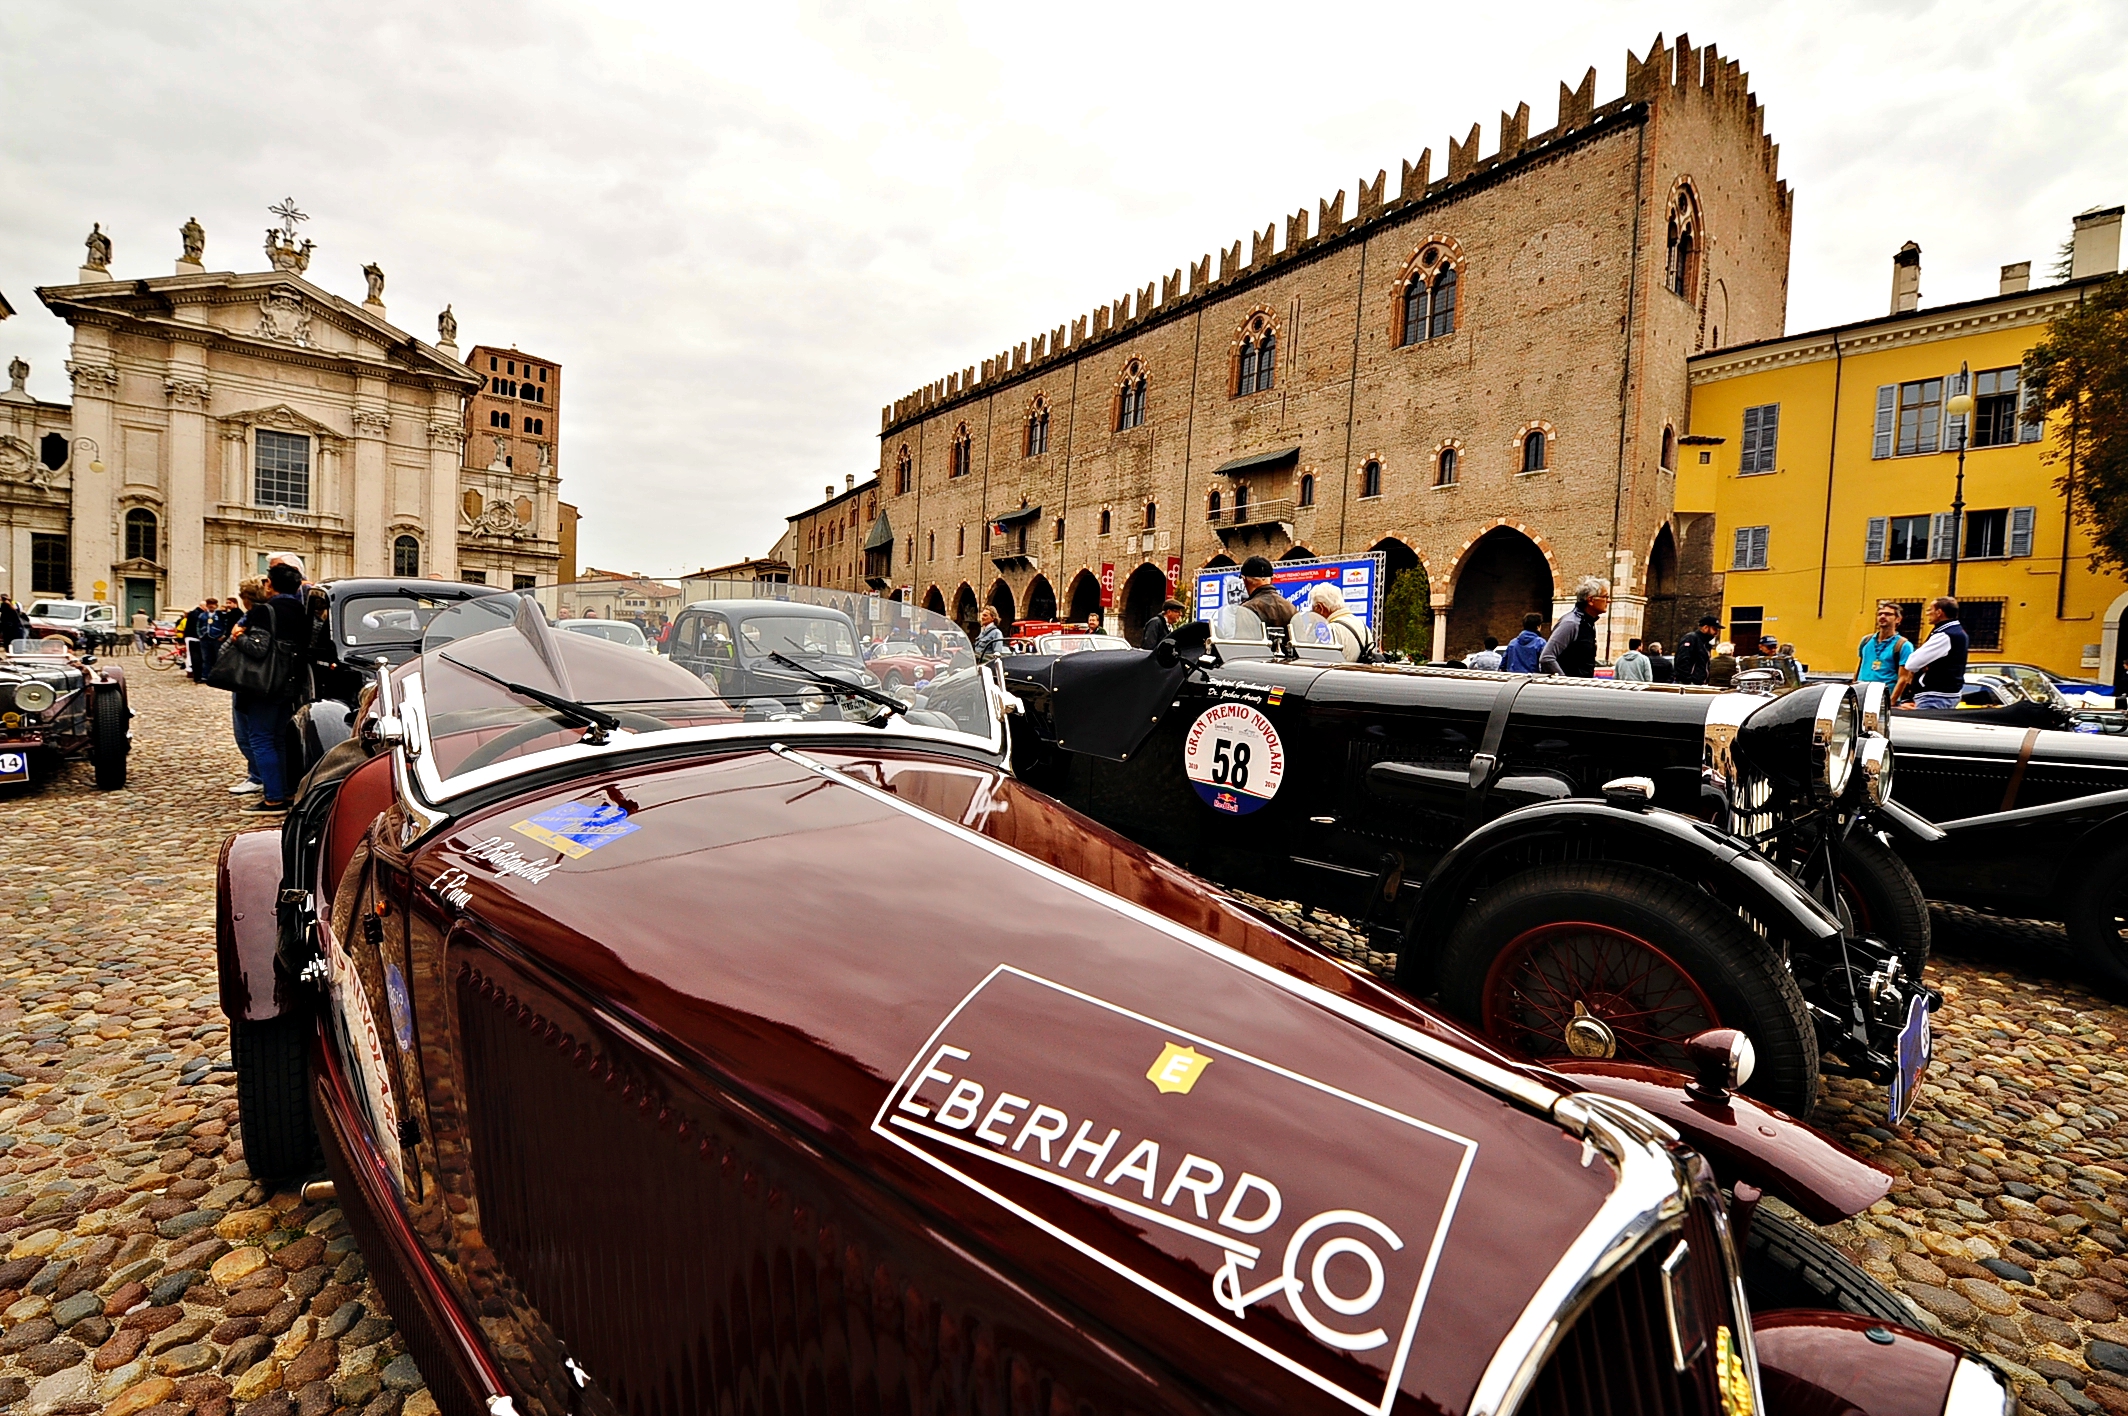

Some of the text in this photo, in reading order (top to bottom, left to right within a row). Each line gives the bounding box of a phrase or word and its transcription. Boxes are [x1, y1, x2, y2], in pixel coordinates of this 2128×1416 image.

[1187, 706, 1282, 775] GRAN PREMIO NUVOLARI
[1188, 762, 1198, 770] 2019
[1212, 738, 1251, 789] 58
[1265, 781, 1276, 789] 2019
[1161, 1054, 1195, 1084] E
[898, 1044, 1283, 1233] EBERHARD
